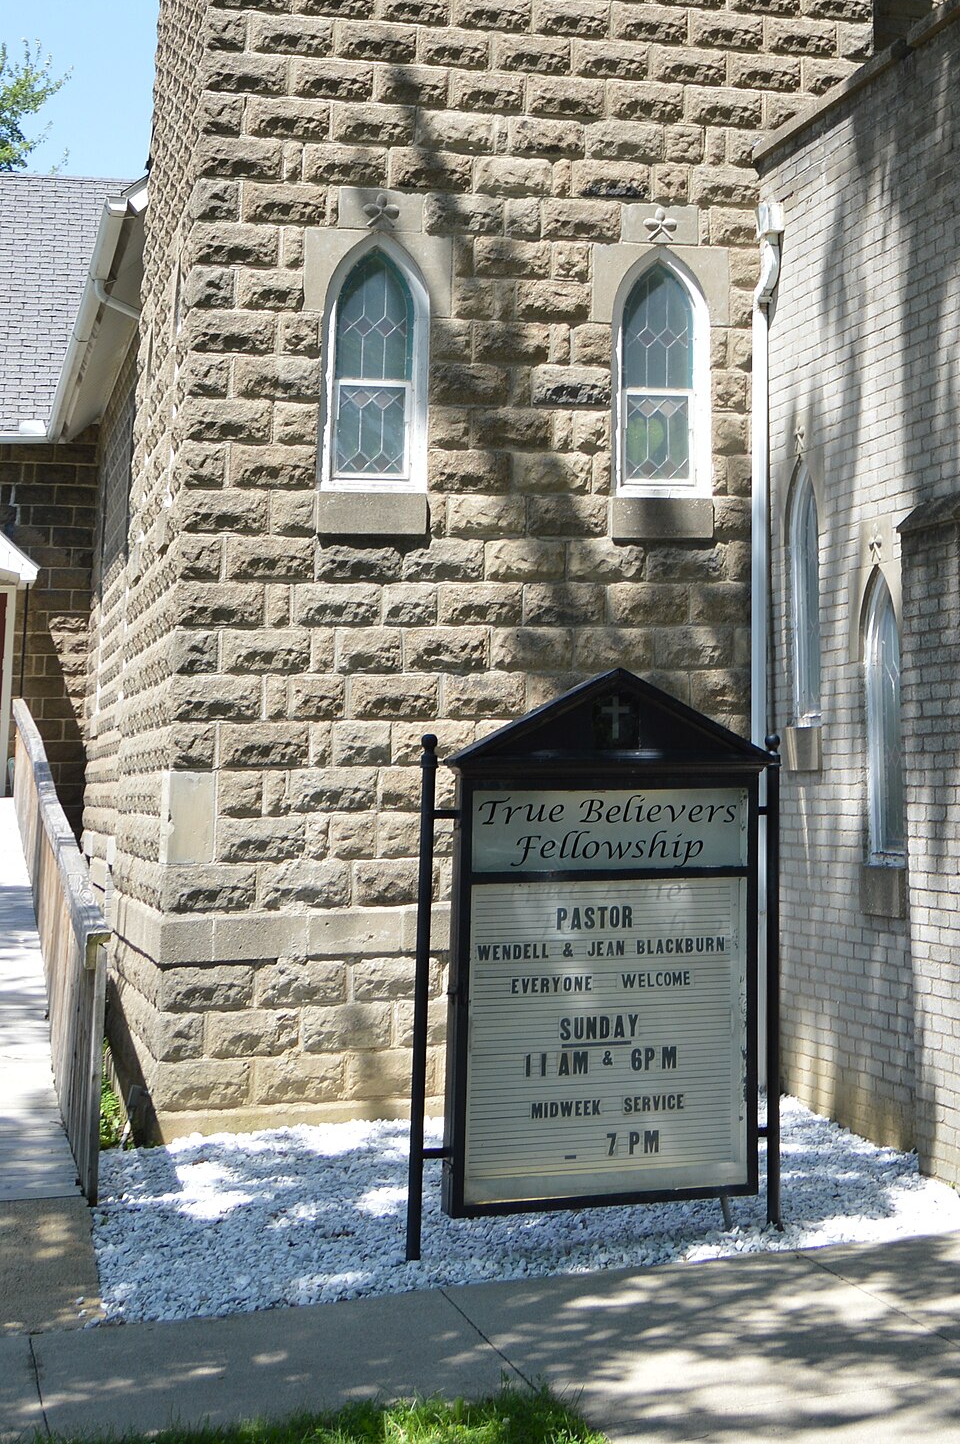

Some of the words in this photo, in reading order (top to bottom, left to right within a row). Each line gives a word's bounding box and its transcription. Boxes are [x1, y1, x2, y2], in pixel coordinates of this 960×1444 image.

[478, 796, 565, 826] True
[579, 794, 737, 824] Believers
[510, 829, 704, 867] Fellowship
[556, 906, 633, 931] PASTOR
[477, 943, 549, 961] WENDELL
[563, 942, 574, 957] &
[587, 940, 625, 957] JEAN
[636, 936, 725, 955] BLACKBURN
[511, 975, 593, 994] EVERYONE
[621, 971, 690, 989] WELCOME
[560, 1014, 639, 1041] SUNDAY
[602, 1050, 613, 1066] &
[531, 1099, 601, 1119] MIDWEEK
[623, 1094, 685, 1112] SERVICE
